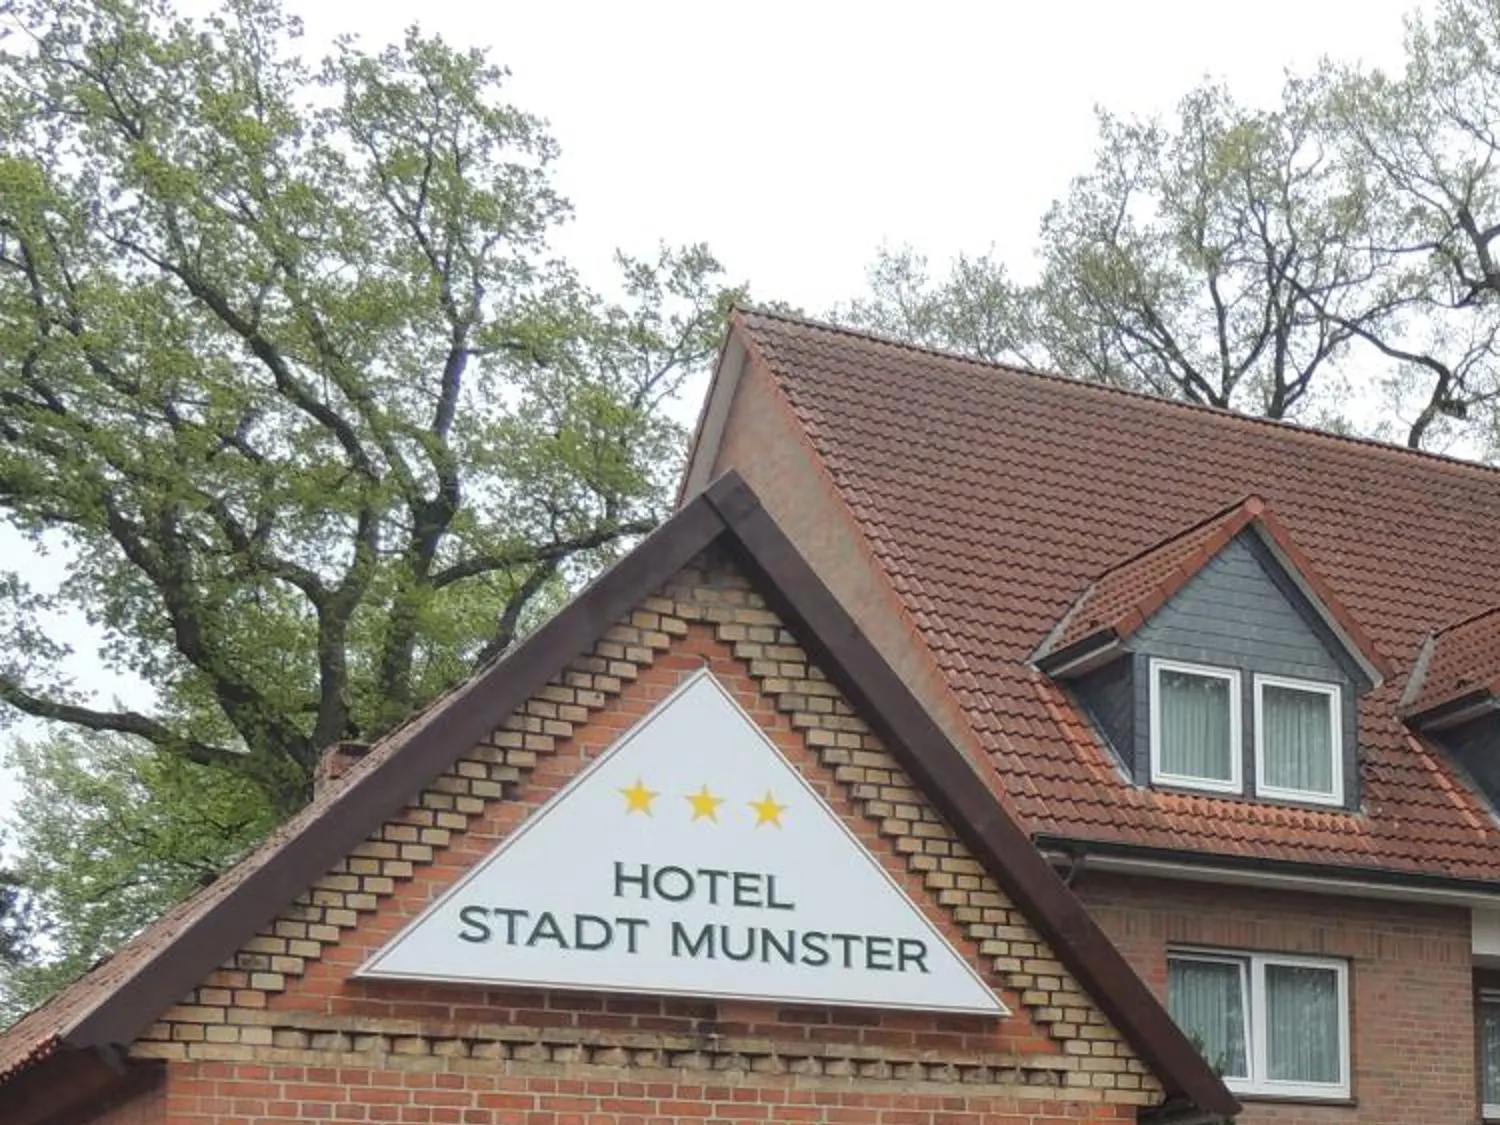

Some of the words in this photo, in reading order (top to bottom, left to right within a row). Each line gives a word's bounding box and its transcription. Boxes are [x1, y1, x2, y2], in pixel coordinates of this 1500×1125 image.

[613, 861, 796, 912] HOTEL
[458, 905, 650, 954] STADT
[671, 920, 931, 974] MUNSTER
